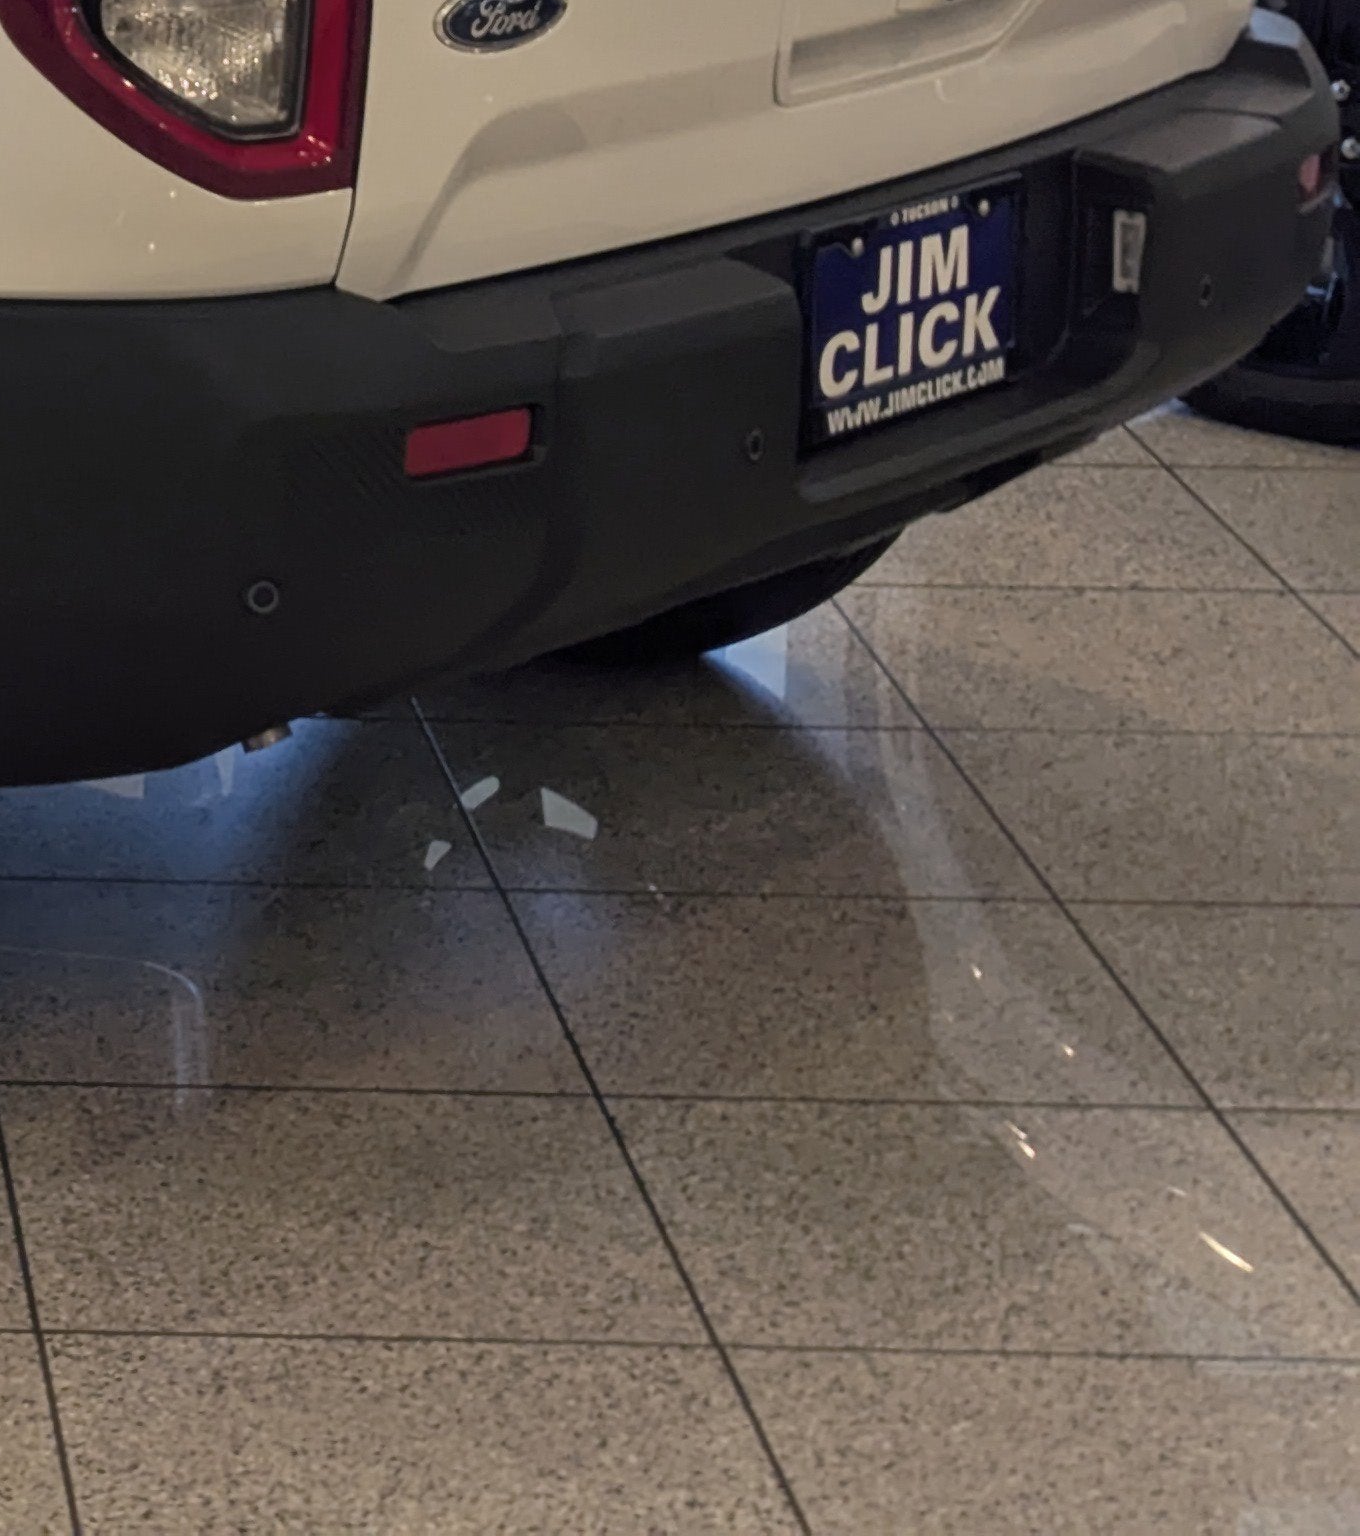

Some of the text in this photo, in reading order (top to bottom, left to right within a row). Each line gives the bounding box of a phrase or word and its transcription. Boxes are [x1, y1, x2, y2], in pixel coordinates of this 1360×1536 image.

[902, 197, 950, 224] TUCSON
[861, 224, 969, 314] JIM
[818, 284, 1002, 399] CLICK
[827, 355, 1005, 437] WWW.JIMCLICK.COM
